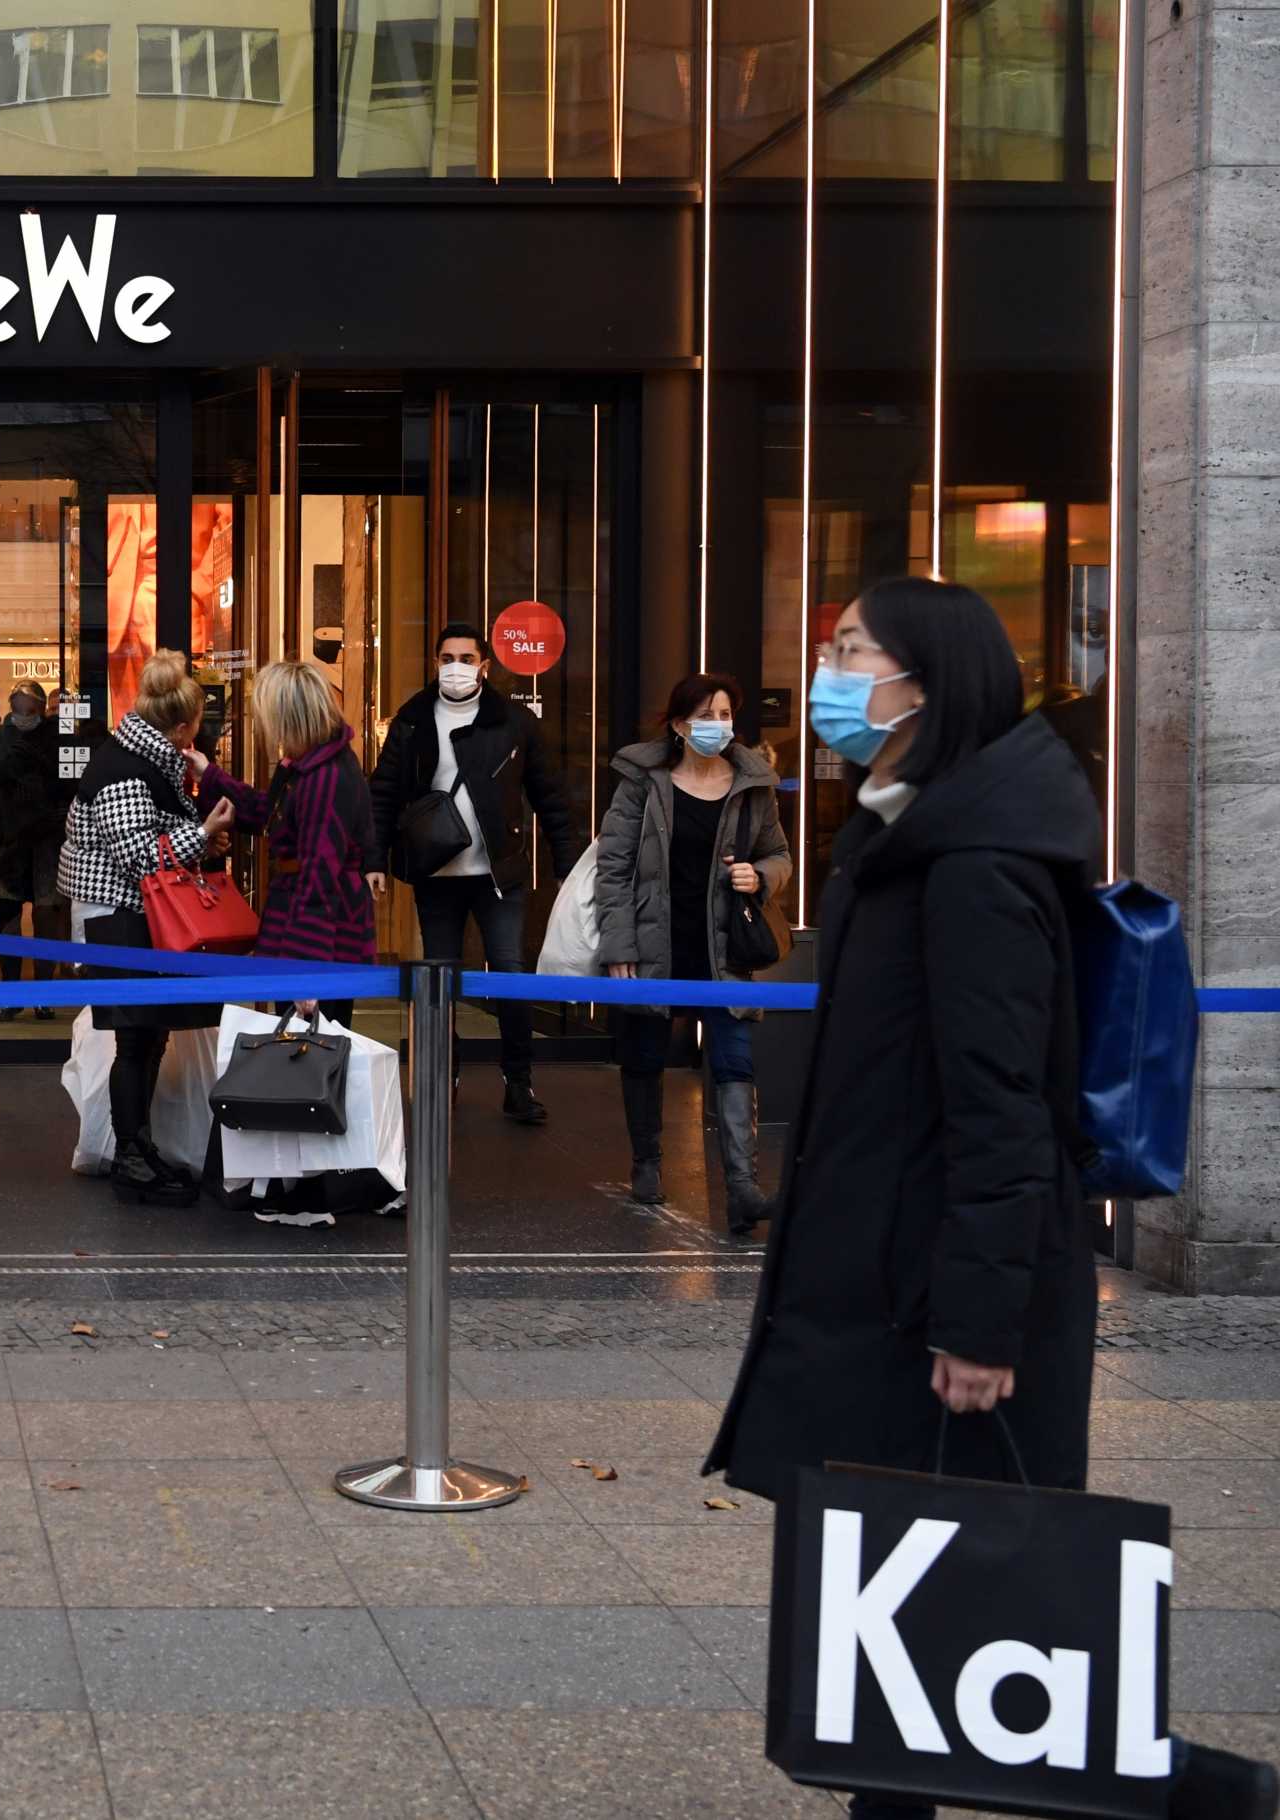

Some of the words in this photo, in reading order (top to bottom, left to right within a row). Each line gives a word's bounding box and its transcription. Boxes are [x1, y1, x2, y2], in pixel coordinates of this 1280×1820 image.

[503, 630, 527, 640] 50%
[513, 642, 544, 653] SALE
[12, 660, 61, 679] DIOR
